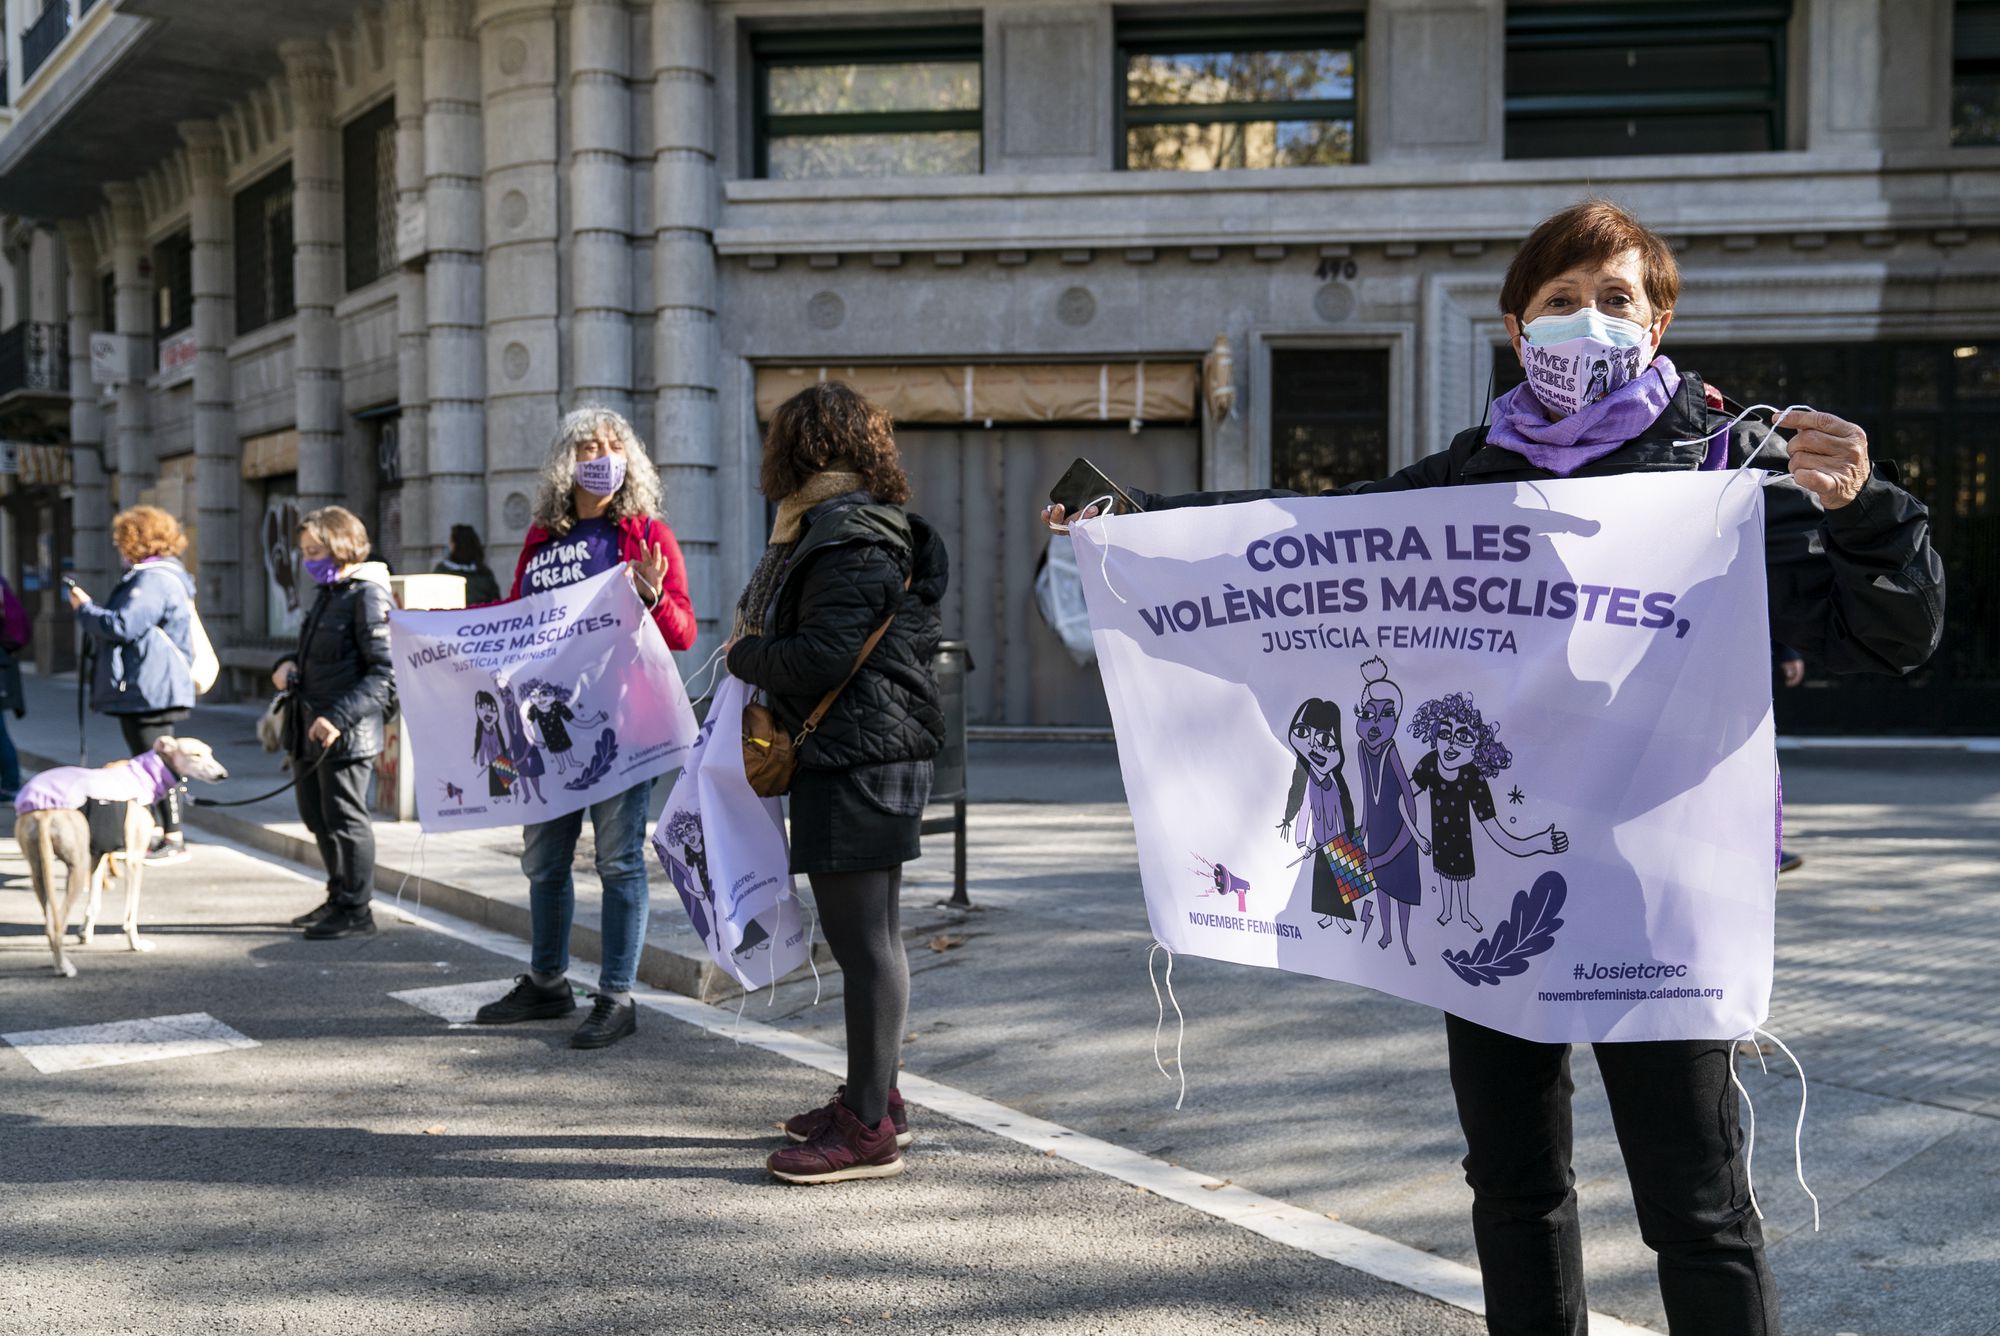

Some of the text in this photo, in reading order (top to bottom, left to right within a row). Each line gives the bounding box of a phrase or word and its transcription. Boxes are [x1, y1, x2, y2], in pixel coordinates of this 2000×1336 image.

[1532, 364, 1576, 392] REBELS
[1535, 384, 1577, 406] NOVEMBRE
[1246, 524, 1531, 572] CONTRA LES
[531, 562, 586, 588] CREAR
[457, 606, 567, 638] CONTRA LES
[1137, 576, 1692, 640] VIOLÈNCIES MASCLISTES,
[408, 612, 621, 669] VIOLÈNCIES MASCLISTES,
[1261, 623, 1518, 655] JUSTÍCIA FEMINISTA
[502, 646, 557, 666] FEMINISTA
[1188, 911, 1302, 941] NOVEMBRE FEMINISTA
[1573, 962, 1688, 981] #Josietcrec
[1538, 985, 1724, 1002] novembrefeminista.caladona.org
